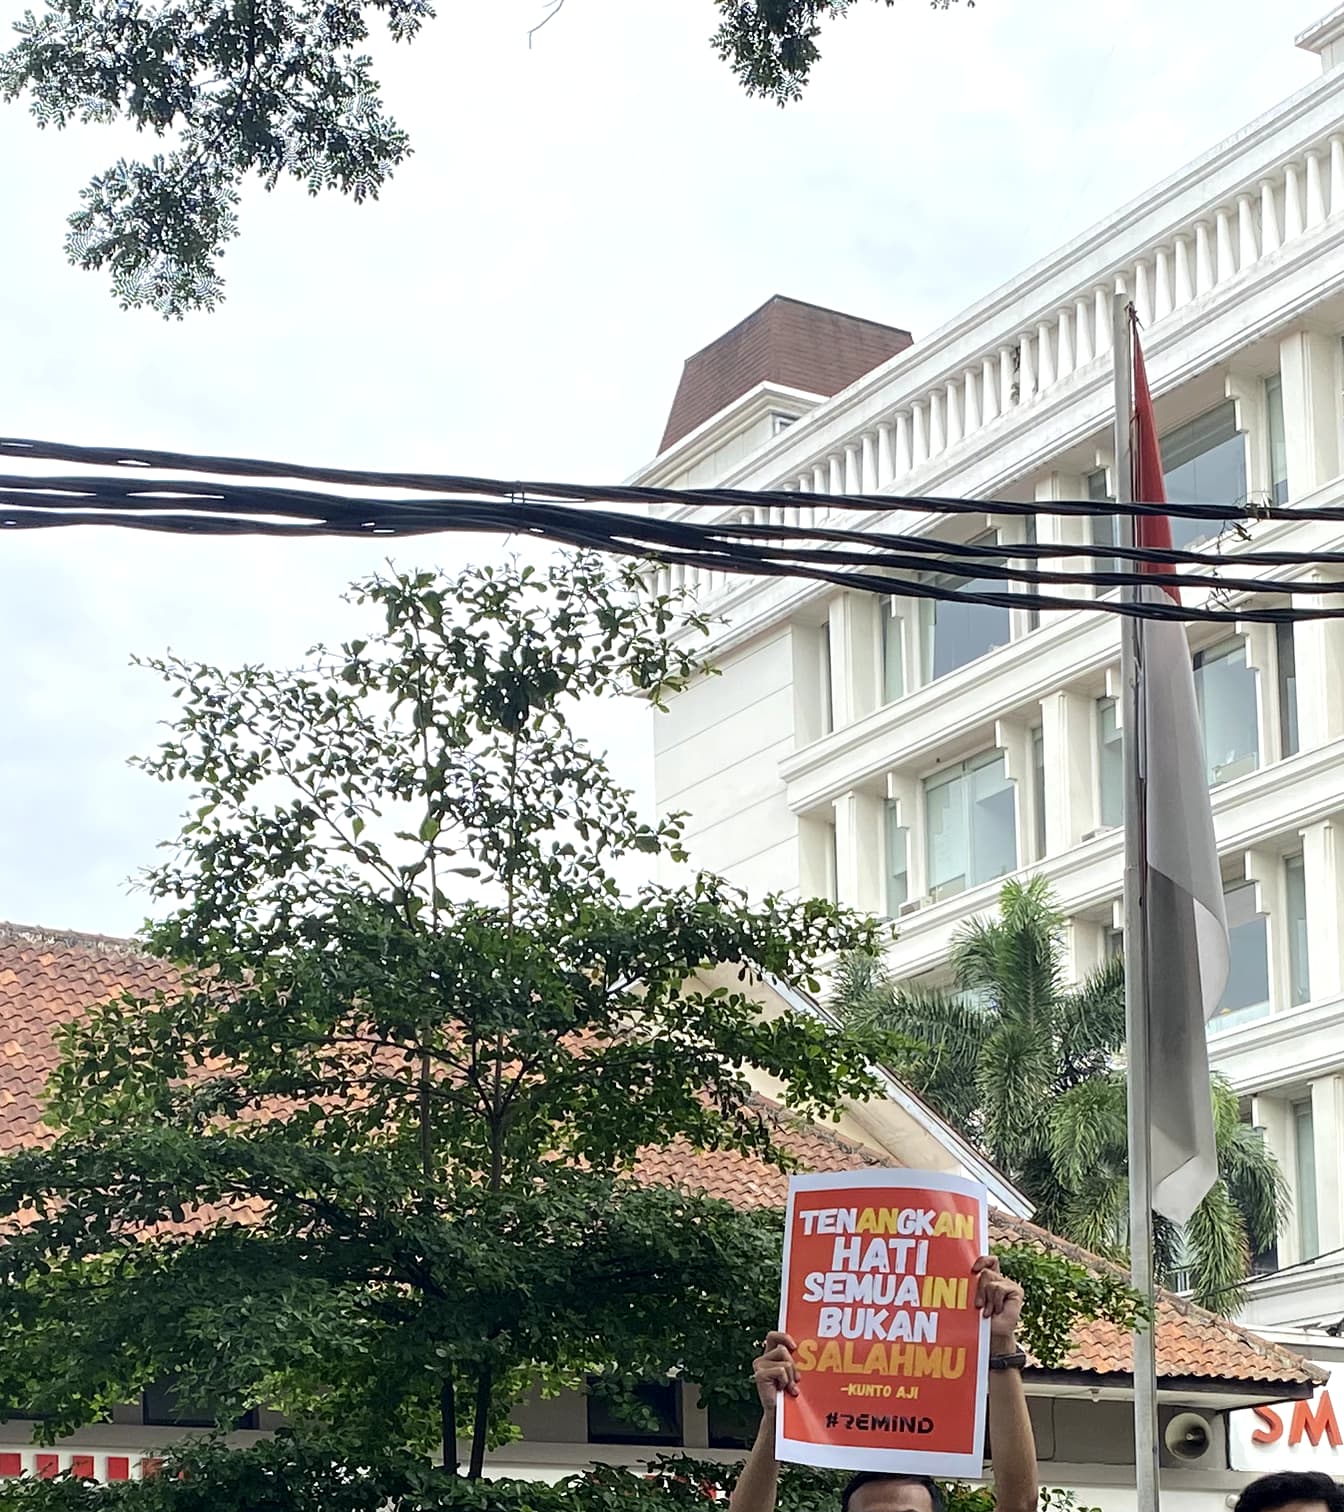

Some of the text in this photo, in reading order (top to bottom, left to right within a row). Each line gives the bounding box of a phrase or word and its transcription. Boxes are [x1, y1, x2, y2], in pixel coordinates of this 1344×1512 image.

[800, 1207, 974, 1240] TENANGKAN
[831, 1236, 928, 1275] HATI
[802, 1272, 968, 1309] SEMUA INI
[817, 1306, 938, 1343] BUKAN
[794, 1340, 966, 1379] SALAHMU
[896, 1386, 918, 1400] AJI
[825, 1411, 934, 1434] #REMIND
